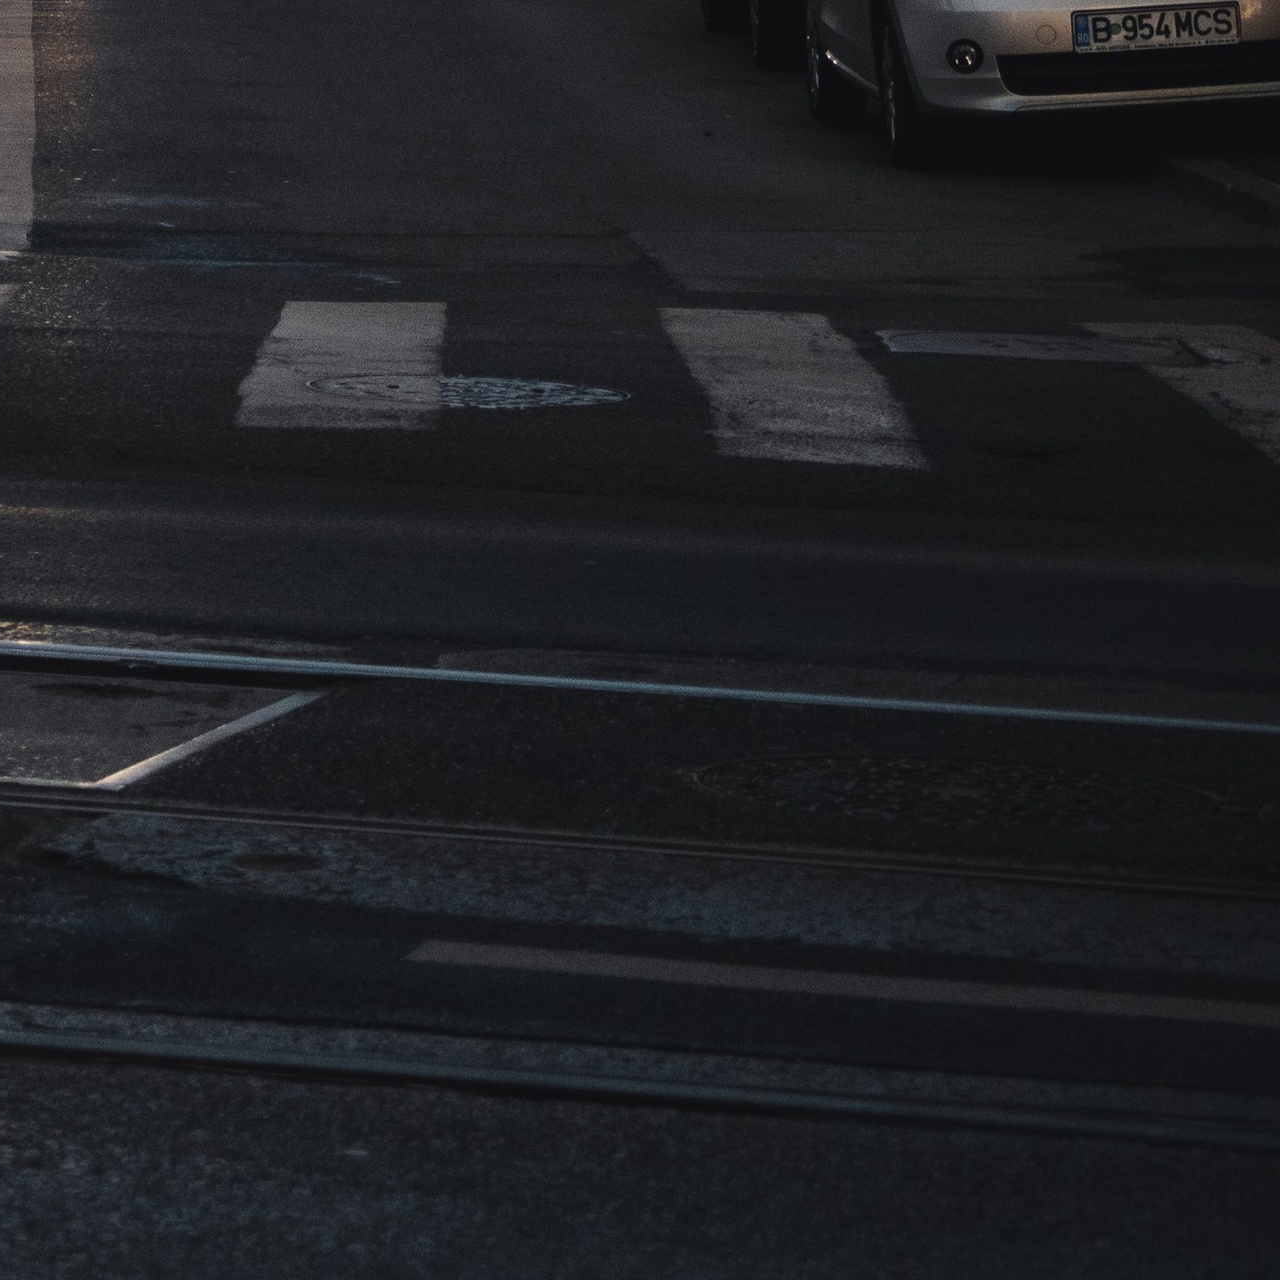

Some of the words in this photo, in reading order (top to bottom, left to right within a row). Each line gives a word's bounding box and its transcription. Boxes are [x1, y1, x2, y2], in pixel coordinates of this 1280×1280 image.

[1091, 16, 1112, 44] B
[1121, 12, 1170, 41] 954
[1174, 8, 1234, 39] MCS
